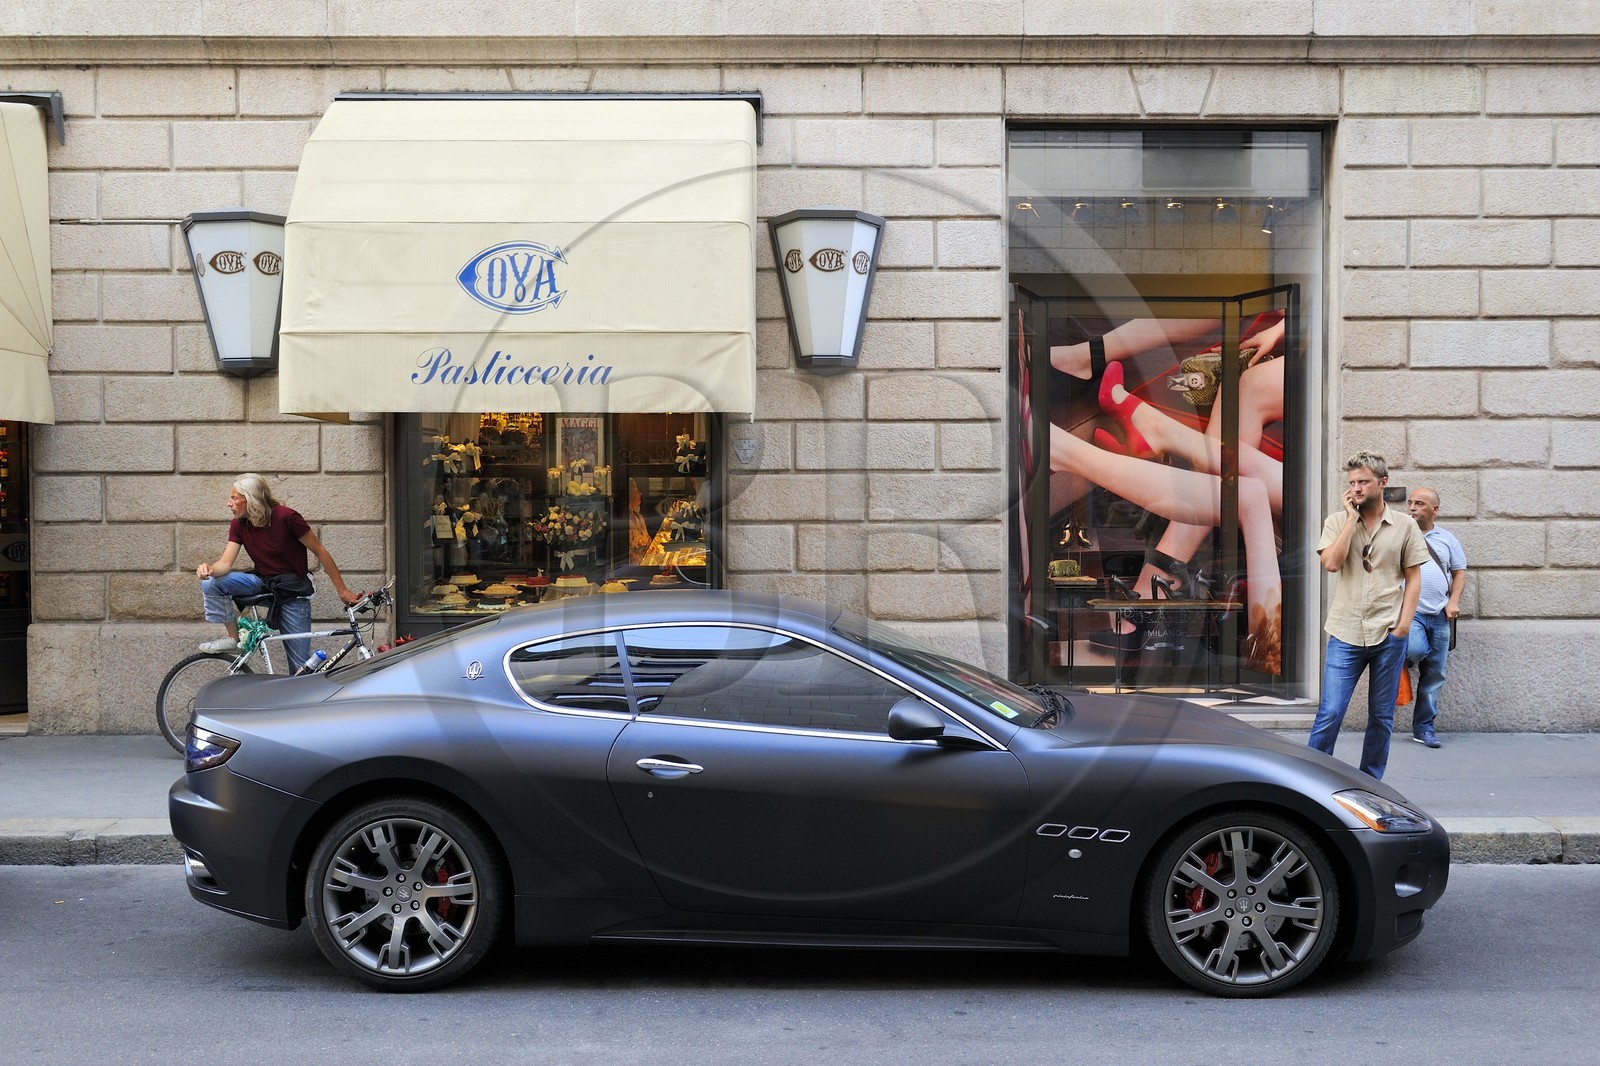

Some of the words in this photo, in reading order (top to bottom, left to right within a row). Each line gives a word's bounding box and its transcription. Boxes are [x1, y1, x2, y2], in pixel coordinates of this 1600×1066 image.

[410, 346, 615, 386] Pasticceria
[561, 418, 599, 429] MAGGI
[1147, 629, 1183, 637] MILANO
